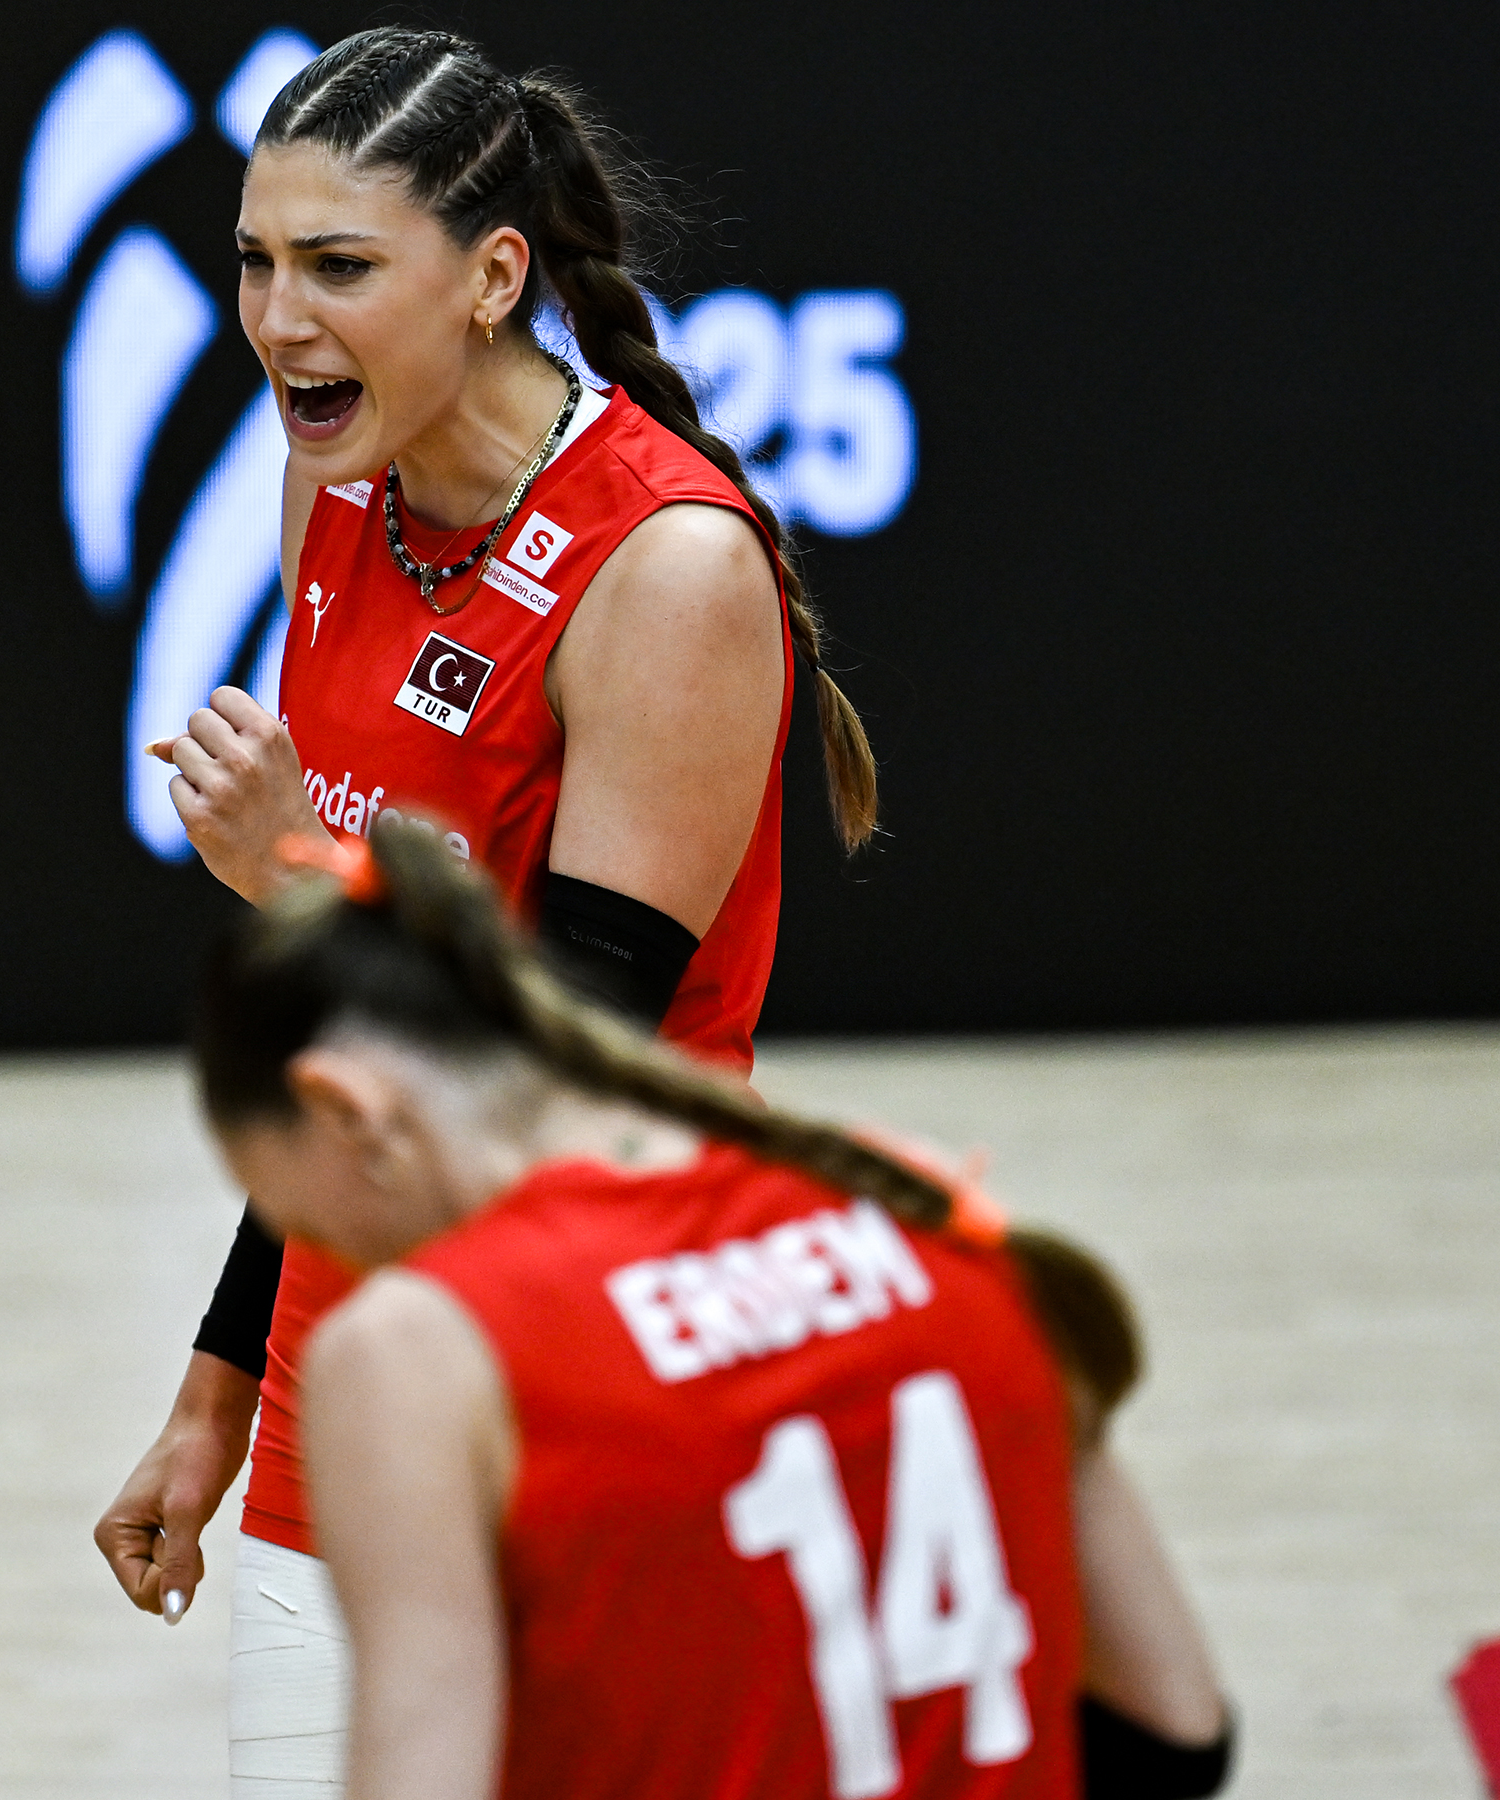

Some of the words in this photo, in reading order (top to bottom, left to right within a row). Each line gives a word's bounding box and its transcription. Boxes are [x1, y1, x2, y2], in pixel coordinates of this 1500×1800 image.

[532, 287, 920, 540] 25
[524, 529, 555, 561] S
[414, 692, 452, 724] TUR
[604, 1196, 935, 1385] ERDEM
[720, 1369, 1036, 1800] 14
